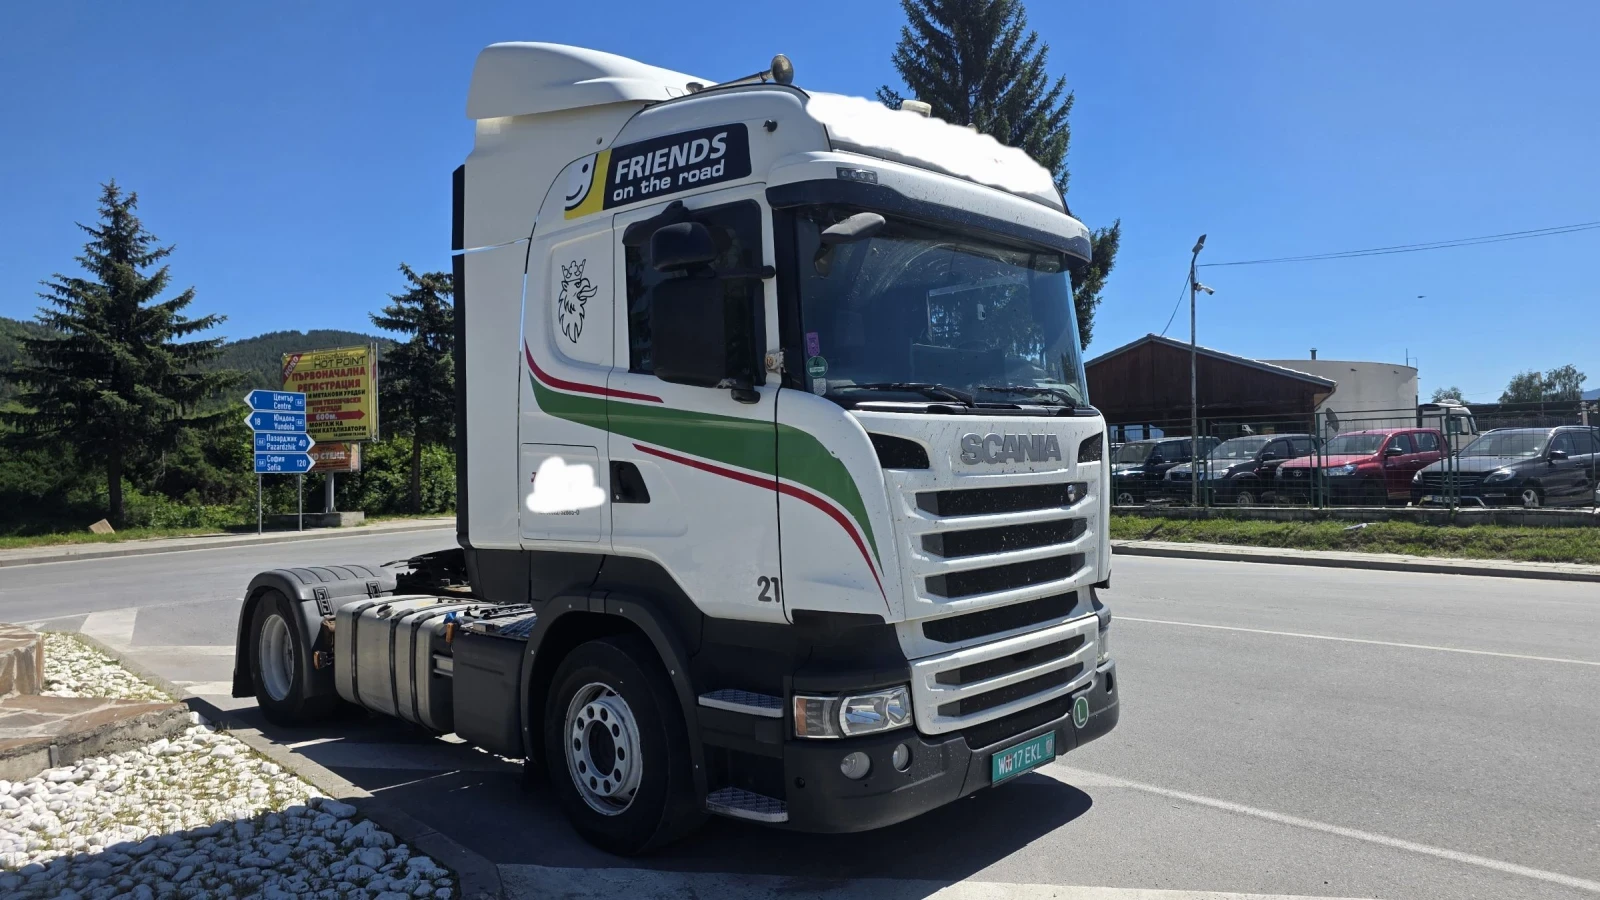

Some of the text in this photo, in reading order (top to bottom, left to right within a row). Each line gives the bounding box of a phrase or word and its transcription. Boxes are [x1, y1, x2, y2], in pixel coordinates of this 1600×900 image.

[615, 132, 728, 184] FRIENDS
[613, 159, 725, 201] on the road
[314, 360, 334, 369] HOT
[336, 356, 365, 367] POINT
[292, 367, 366, 381] ПЪРВОНАЧАЛНА
[297, 379, 361, 392] РЕГИСТРАЦИЯ
[273, 393, 294, 403] Център
[273, 402, 291, 410] Centre
[254, 418, 261, 426] 18
[273, 414, 295, 422] Юндола
[274, 423, 294, 431] Yundola
[266, 434, 297, 443] Пазарджик
[960, 433, 1062, 465] SCANIA
[267, 463, 281, 471] Sofia
[296, 459, 306, 467] 120
[757, 576, 780, 603] 21
[1077, 704, 1085, 722] L
